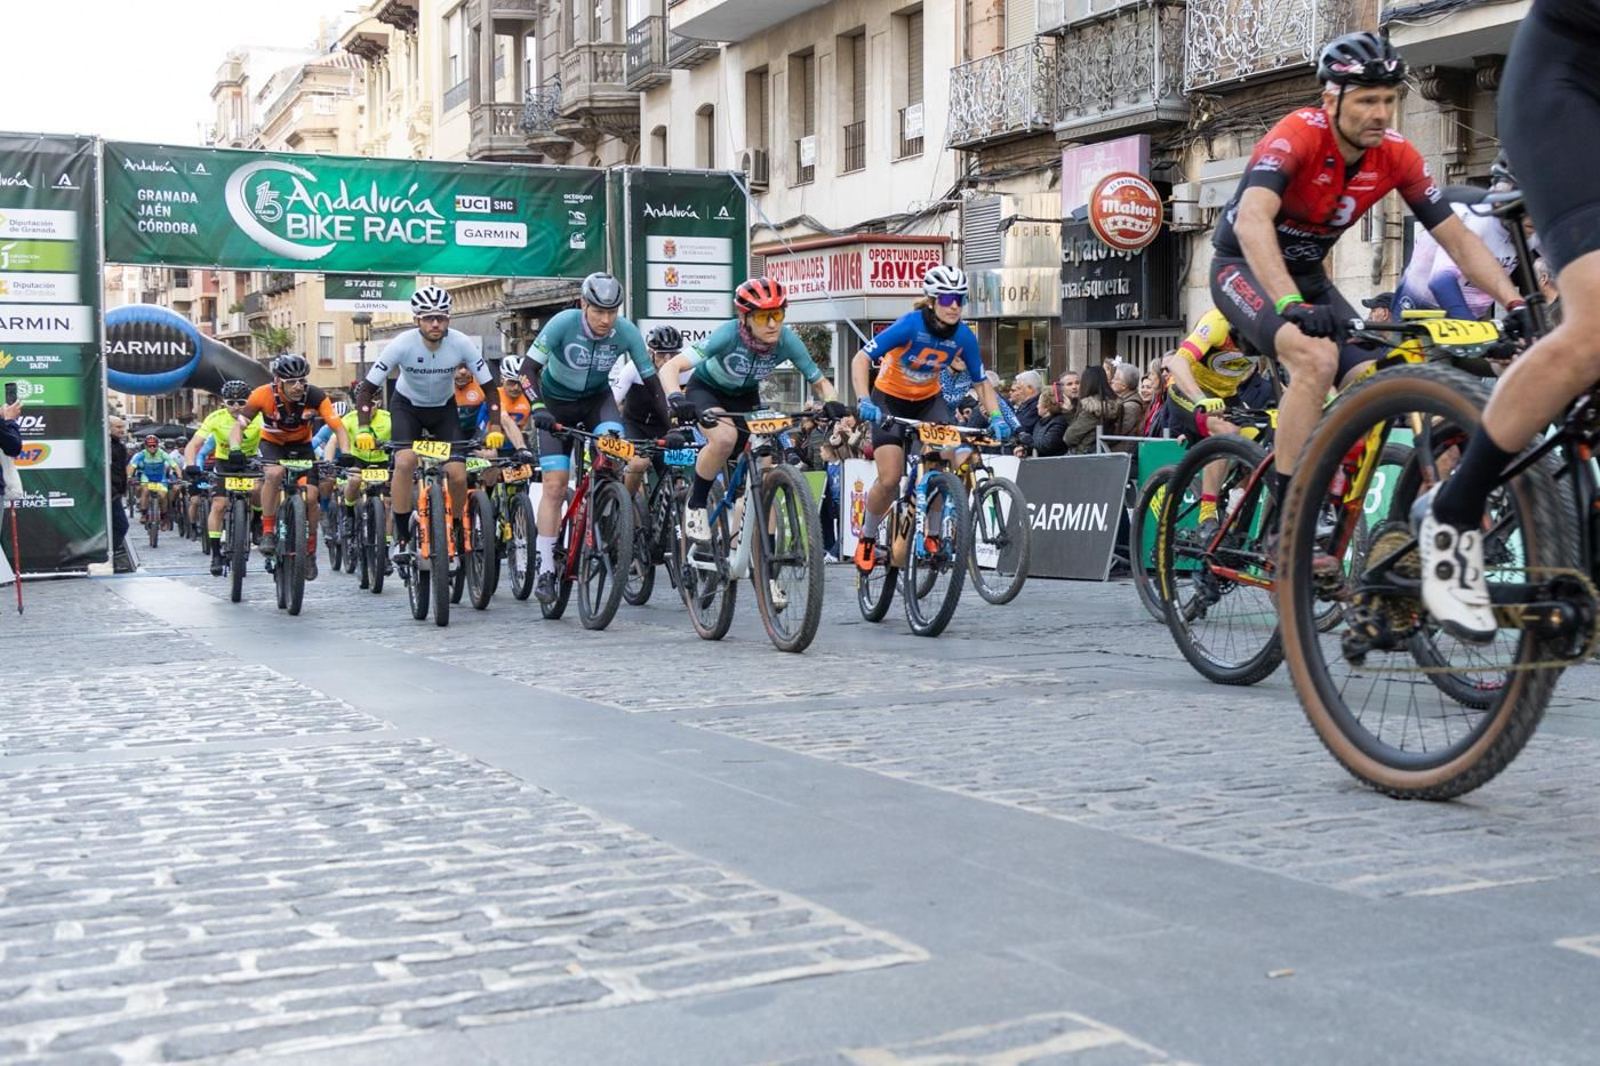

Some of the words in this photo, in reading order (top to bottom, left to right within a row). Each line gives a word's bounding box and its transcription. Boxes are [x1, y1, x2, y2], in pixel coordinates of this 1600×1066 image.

[137, 188, 199, 205] GRANADA
[284, 176, 445, 219] Andalucía
[137, 203, 172, 218] JAÉN
[462, 199, 488, 210] UCI
[643, 202, 701, 220] Andalucía
[1102, 200, 1157, 217] Mahou
[9, 219, 54, 228] Diputación
[21, 226, 56, 234] Granada
[137, 219, 199, 236] CÓRDOBA
[286, 213, 356, 241] BIKE
[363, 216, 447, 245] RACE
[464, 228, 521, 240] GARMIN
[869, 249, 940, 261] OPORTUNIDADES
[828, 252, 863, 291] JAVIER
[13, 281, 55, 290] Diputación
[344, 279, 385, 288] STAGE
[388, 281, 397, 289] 4
[789, 284, 799, 294] EN
[801, 281, 825, 293] TELAS
[360, 289, 382, 298] JAÉN
[1231, 275, 1265, 312] ESPEJO
[1115, 302, 1139, 320] 1974
[416, 441, 449, 456] 241-2
[364, 469, 387, 479] 213-1
[227, 480, 253, 489] 213-2
